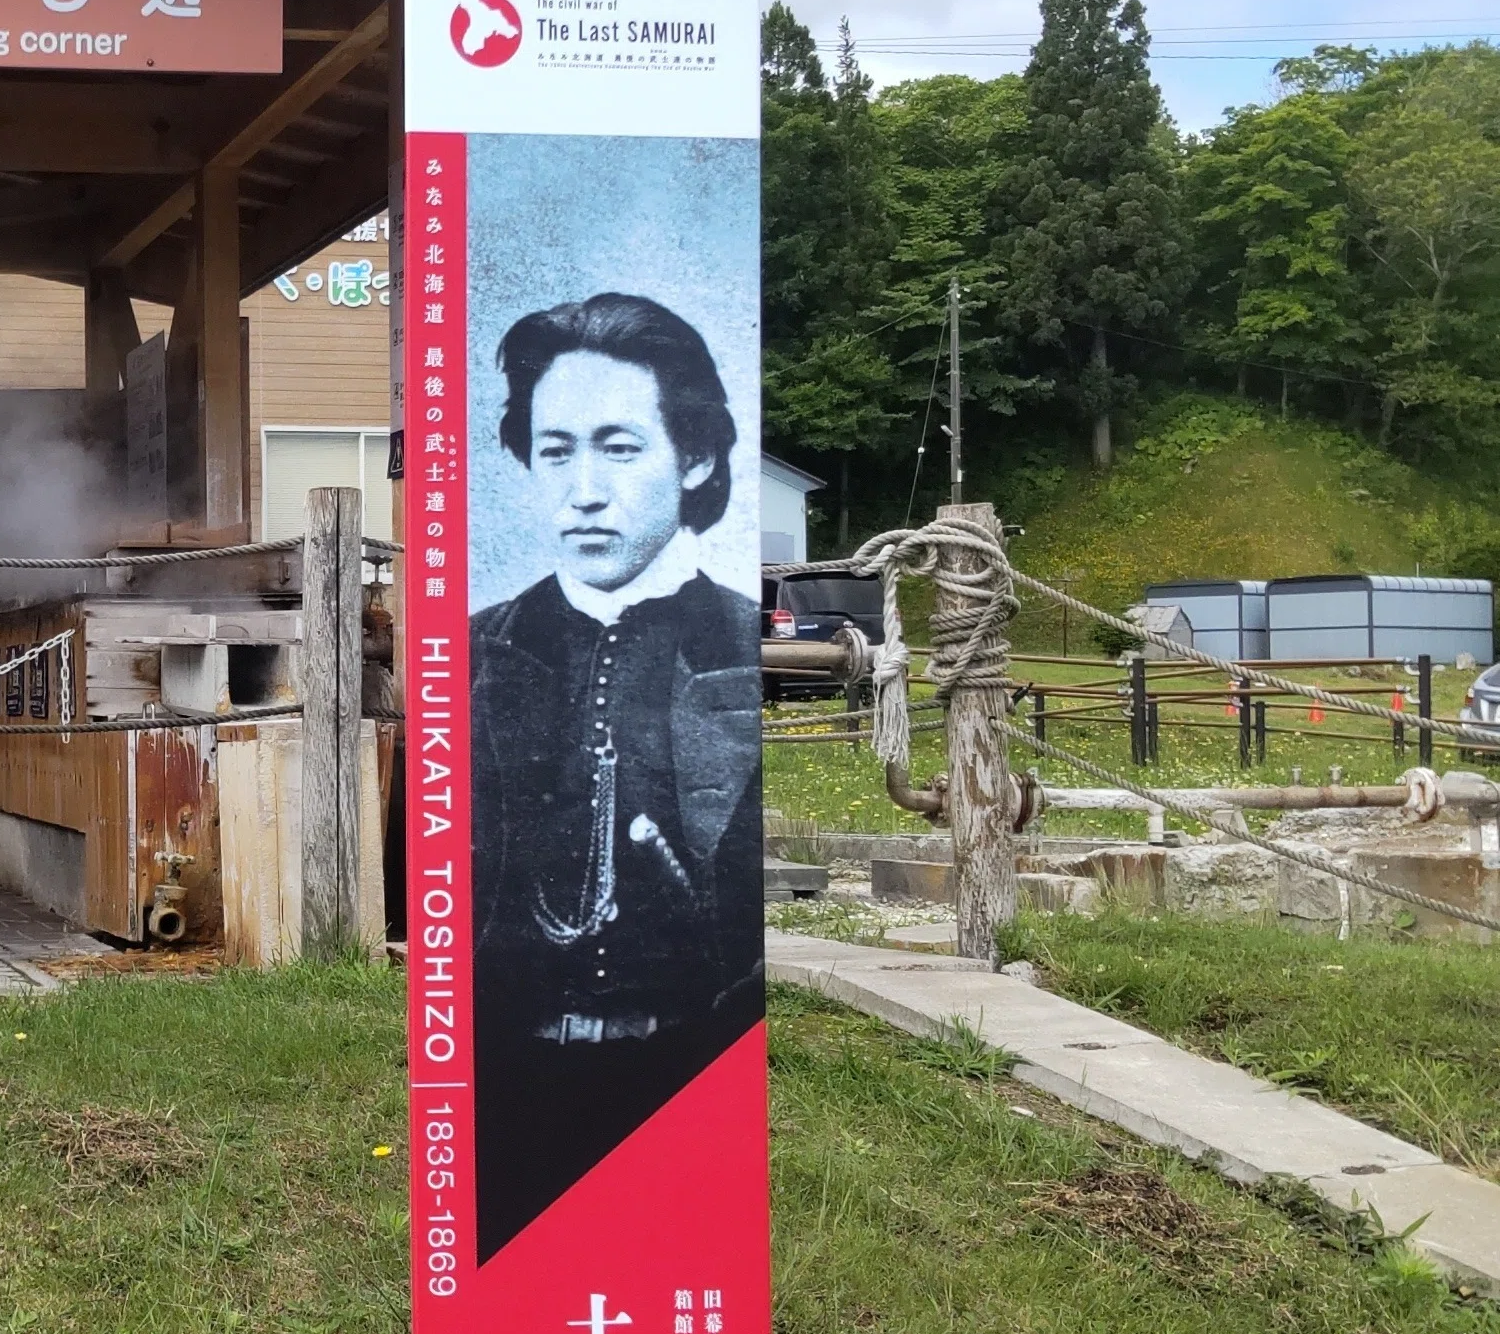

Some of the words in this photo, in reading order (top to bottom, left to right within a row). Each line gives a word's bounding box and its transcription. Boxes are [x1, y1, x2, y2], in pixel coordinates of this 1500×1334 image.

[20, 30, 128, 56] corner
[537, 19, 569, 42] The
[579, 20, 619, 43] Last
[628, 21, 716, 45] SAMURAI
[585, 0, 603, 11] war
[607, 0, 618, 11] of
[424, 159, 445, 324] みなみ北海道
[424, 348, 446, 598] 最後の武士達の物語
[421, 638, 451, 838] HIJIKATA
[423, 860, 455, 1062] TOSHIZO
[426, 1102, 456, 1297] 1835-1869
